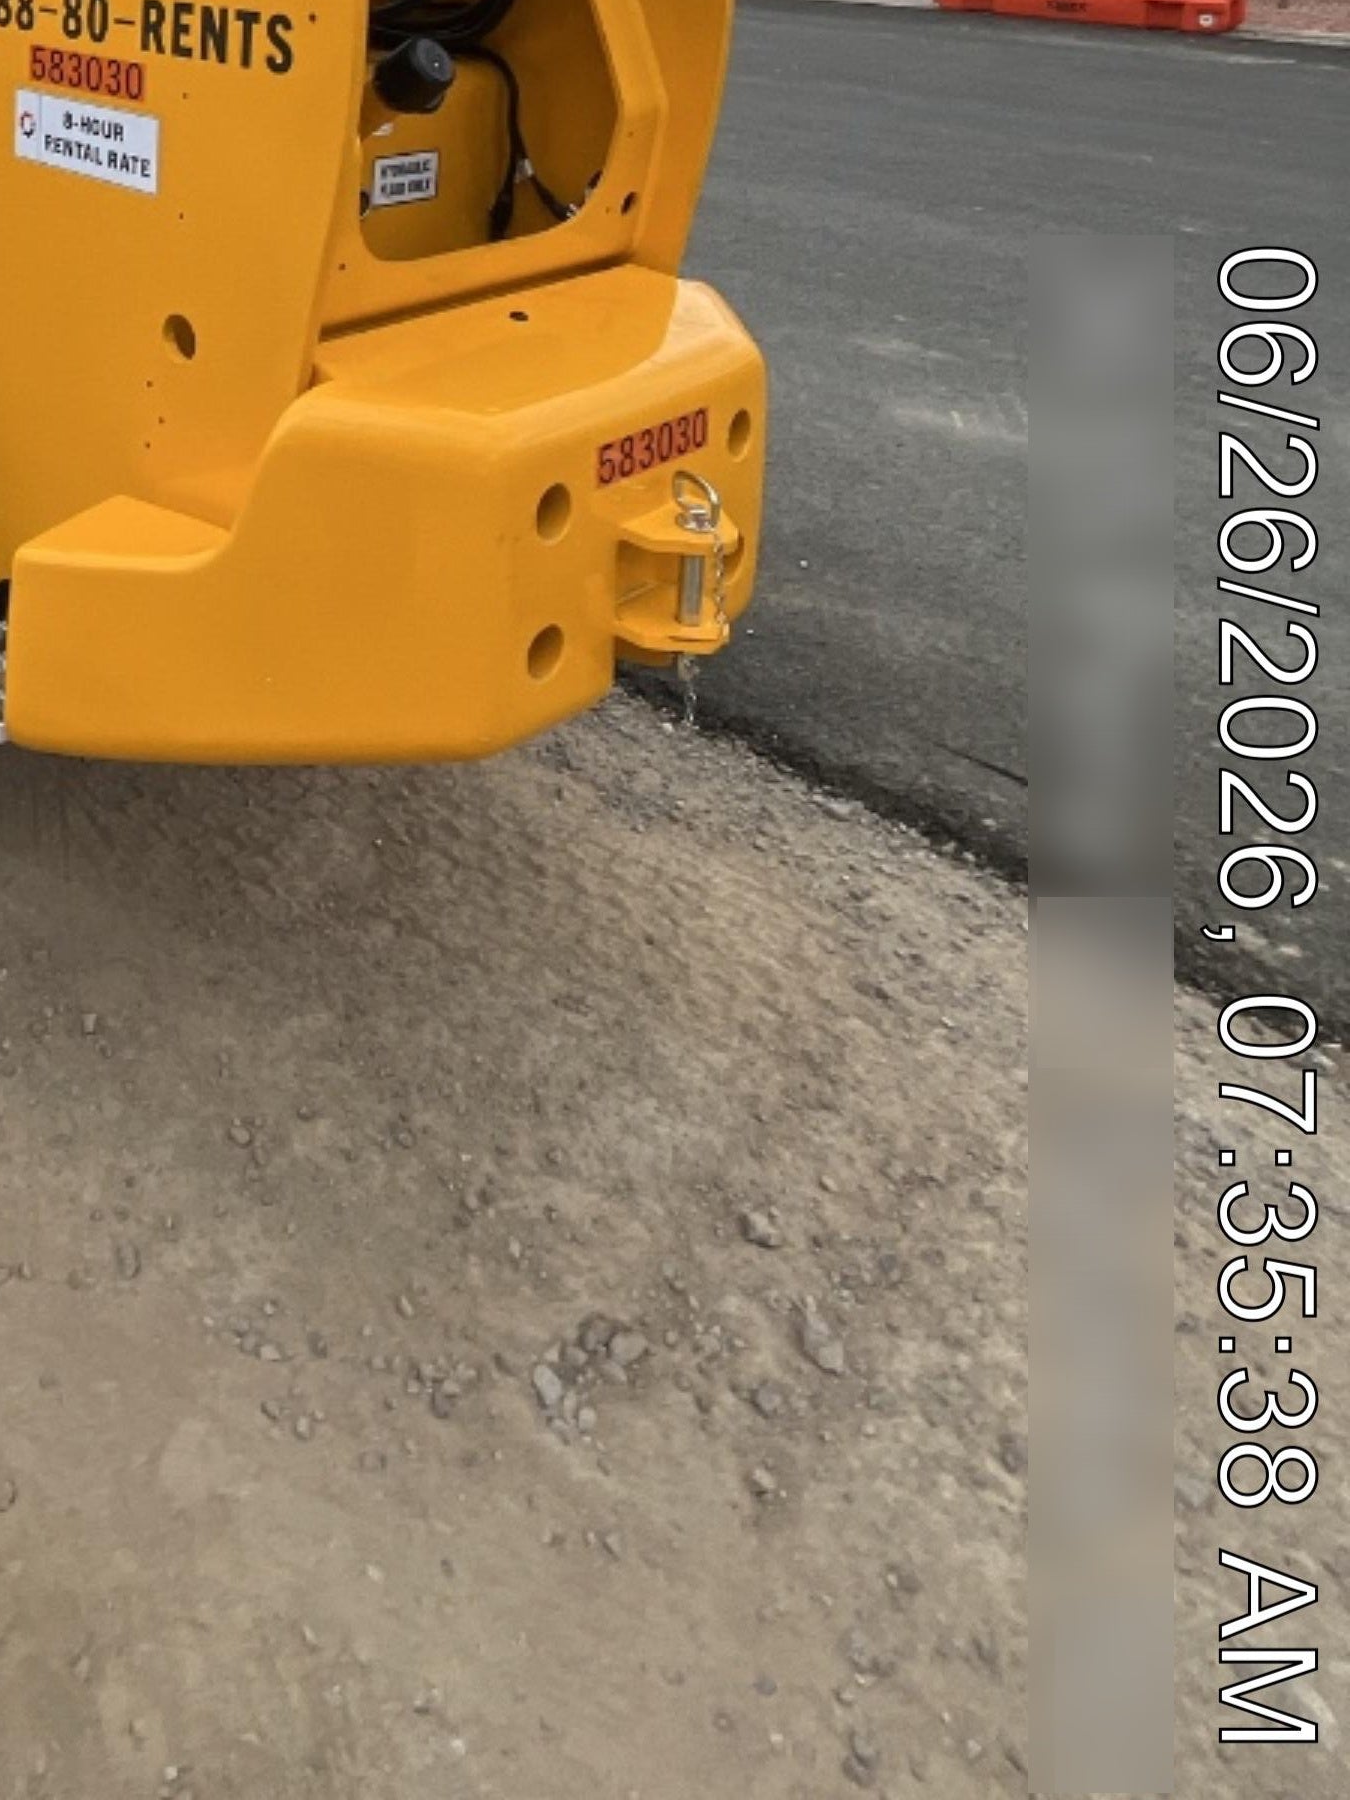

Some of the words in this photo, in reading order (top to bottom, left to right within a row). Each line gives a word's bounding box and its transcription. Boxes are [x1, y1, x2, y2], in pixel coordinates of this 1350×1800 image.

[31, 45, 143, 100] 583030
[62, 110, 125, 142] 8-HOUR
[44, 133, 103, 166] RENTAL
[107, 149, 151, 178] RATE
[599, 407, 710, 484] 583030
